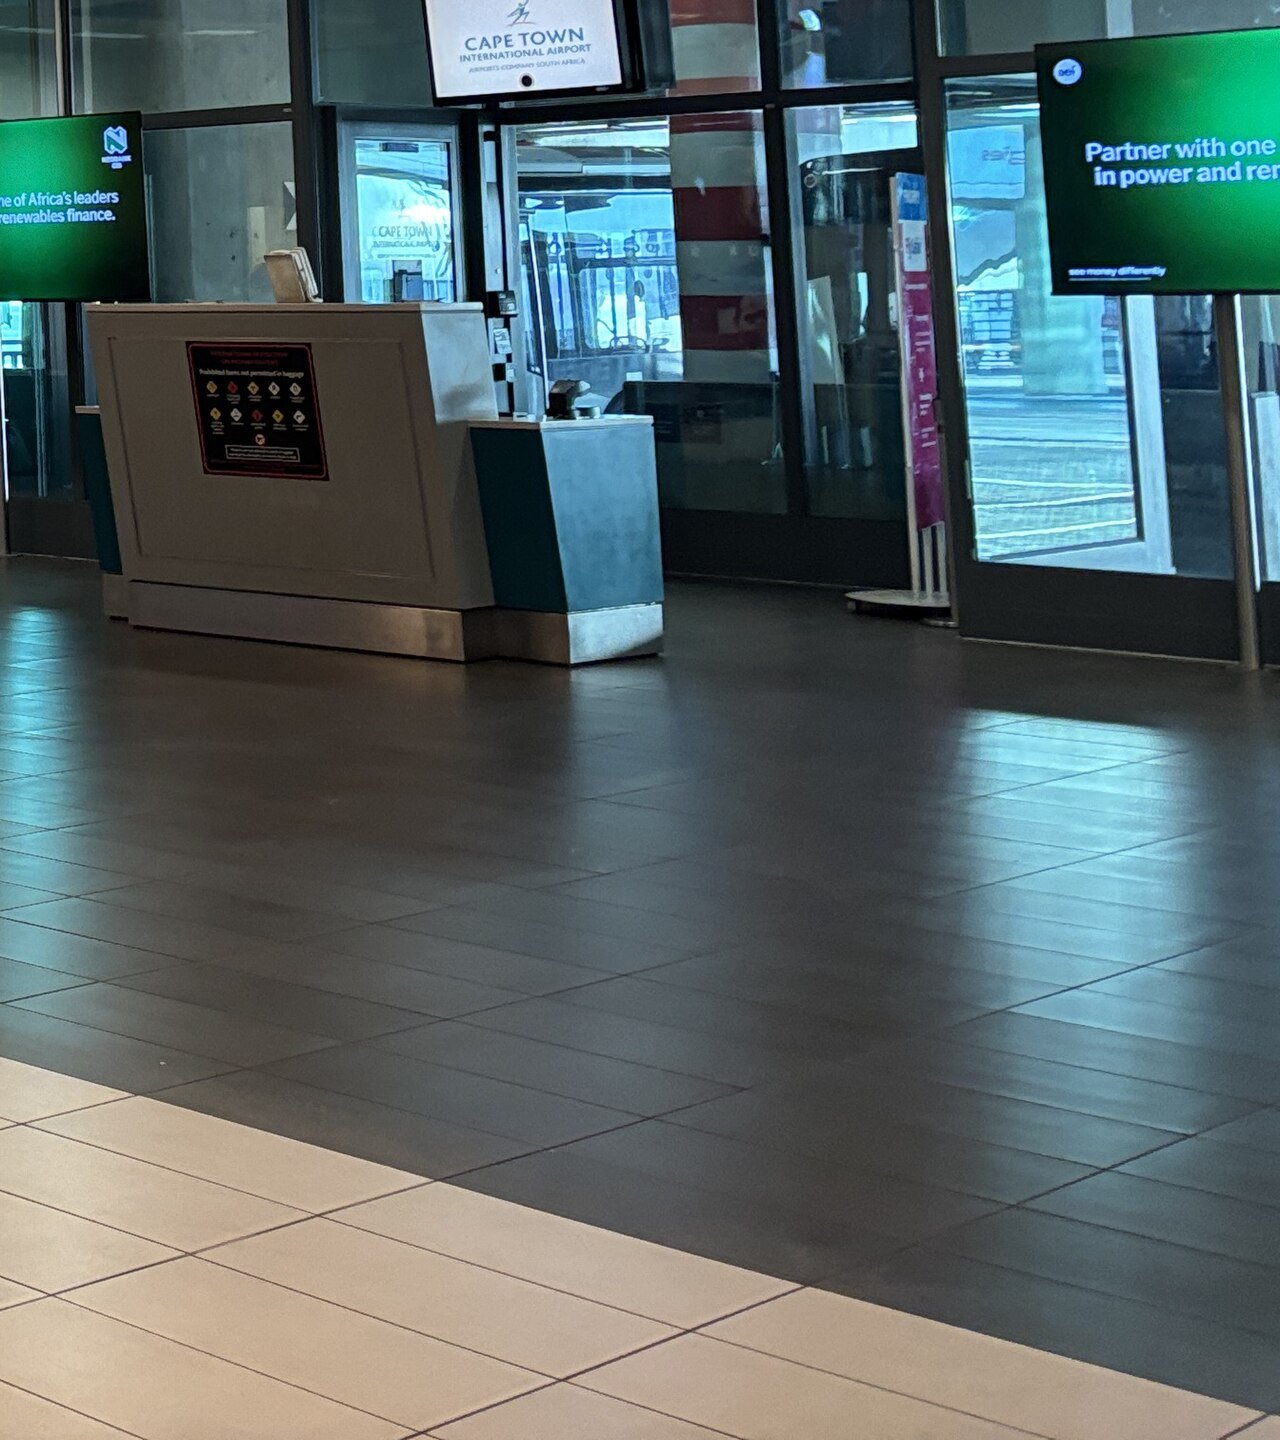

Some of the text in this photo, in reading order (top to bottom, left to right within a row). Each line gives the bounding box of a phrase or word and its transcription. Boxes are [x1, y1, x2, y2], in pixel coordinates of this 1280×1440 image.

[465, 27, 584, 51] CAPE TOWN
[459, 44, 591, 63] INTERNATIONAL AIRPORT
[1085, 137, 1276, 162] Partner with one
[1093, 166, 1116, 186] in
[1120, 167, 1193, 189] power
[1196, 161, 1241, 183] and
[13, 193, 27, 207] of
[28, 191, 72, 206] Africa's
[73, 190, 120, 205] leaders
[67, 207, 117, 222] finance.
